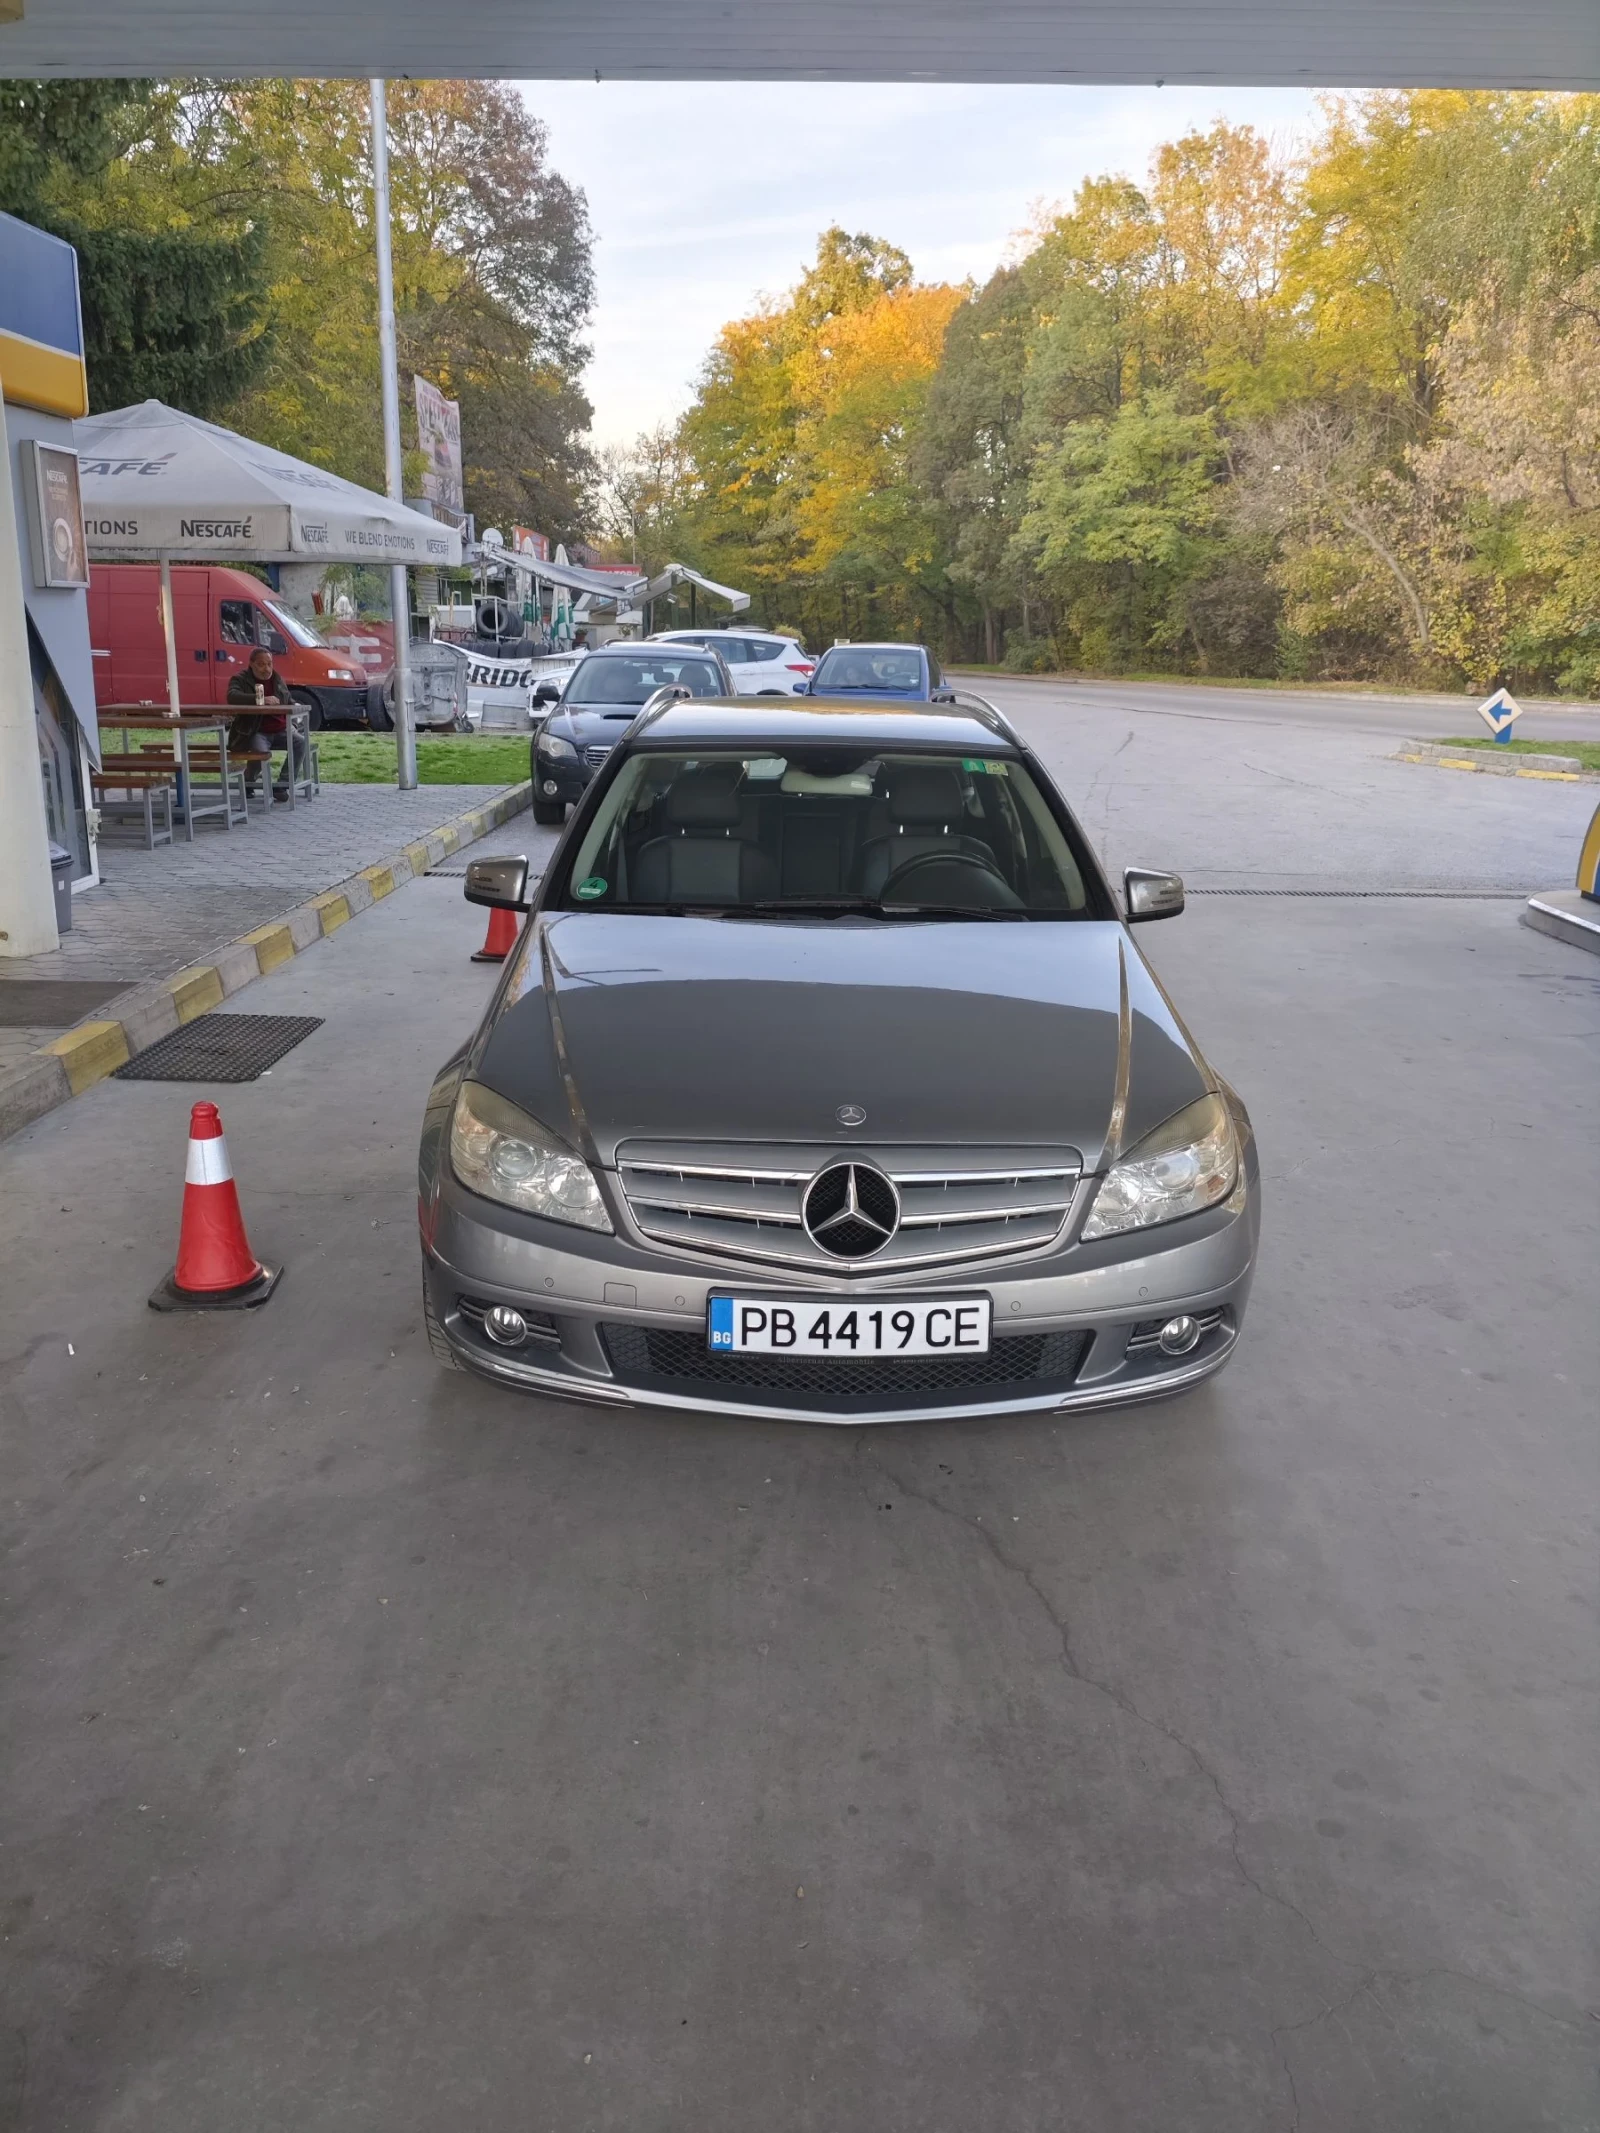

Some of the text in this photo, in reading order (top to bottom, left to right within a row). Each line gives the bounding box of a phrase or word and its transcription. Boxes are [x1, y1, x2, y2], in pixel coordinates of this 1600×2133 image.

[180, 516, 253, 538] NESCAFÉ
[345, 530, 416, 550] WE BLEND EMOTIONS
[713, 1331, 732, 1344] BG
[741, 1307, 980, 1349] PB 4419 CE
